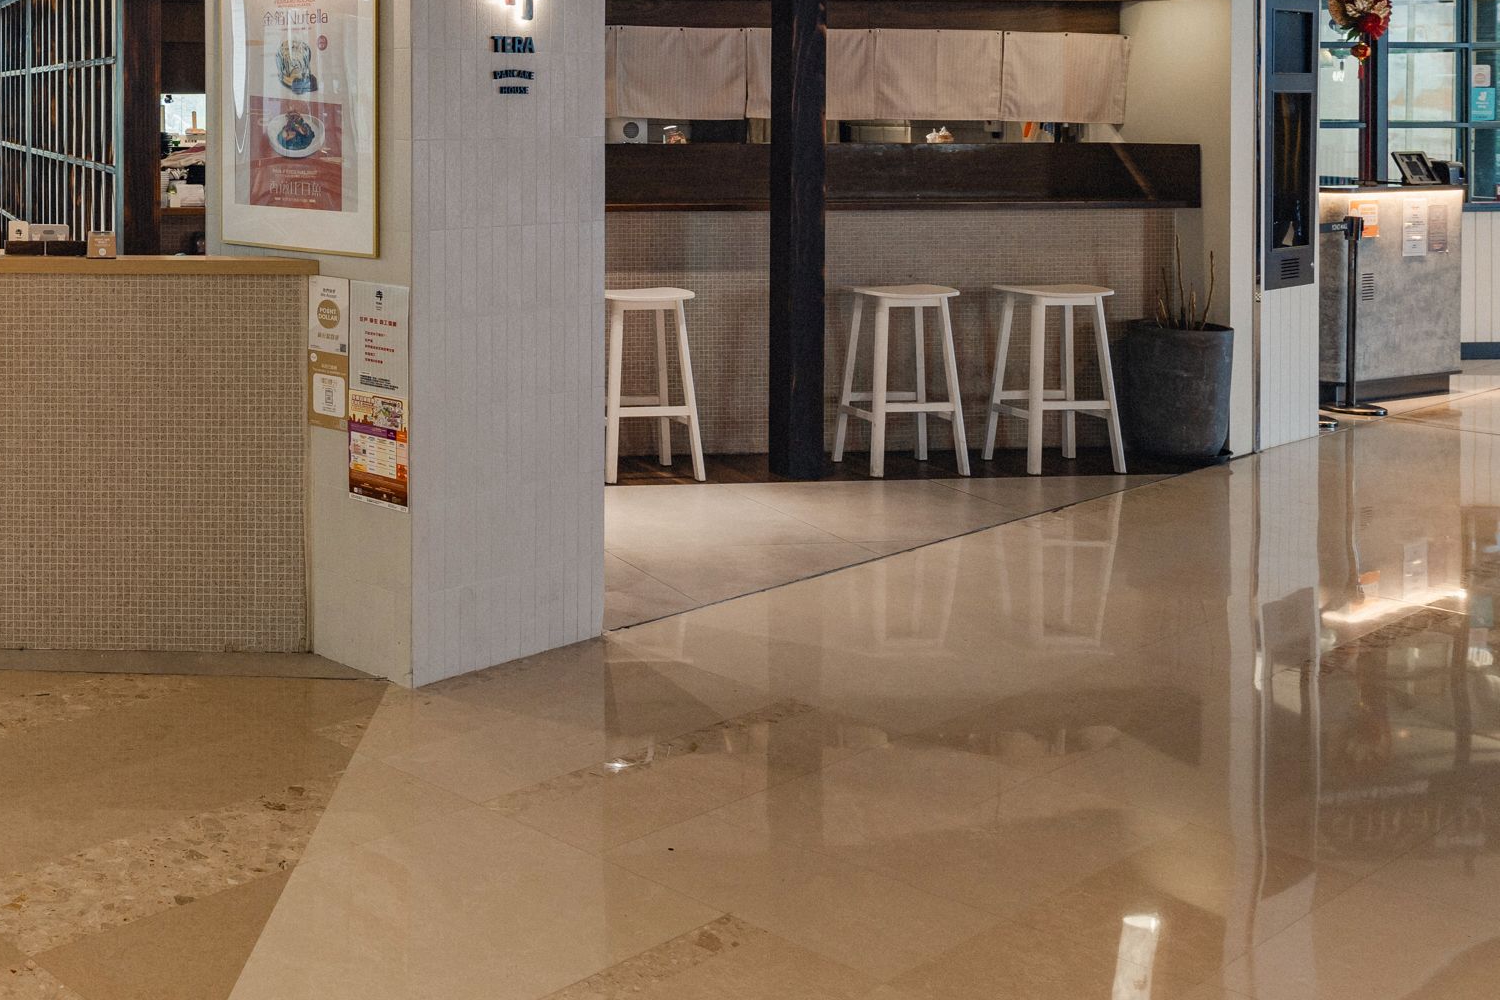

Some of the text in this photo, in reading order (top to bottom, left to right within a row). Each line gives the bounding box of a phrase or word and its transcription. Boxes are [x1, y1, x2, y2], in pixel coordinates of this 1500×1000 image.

[491, 36, 535, 53] TERA
[493, 69, 535, 80] PANCAKE
[499, 86, 530, 94] HOUSE
